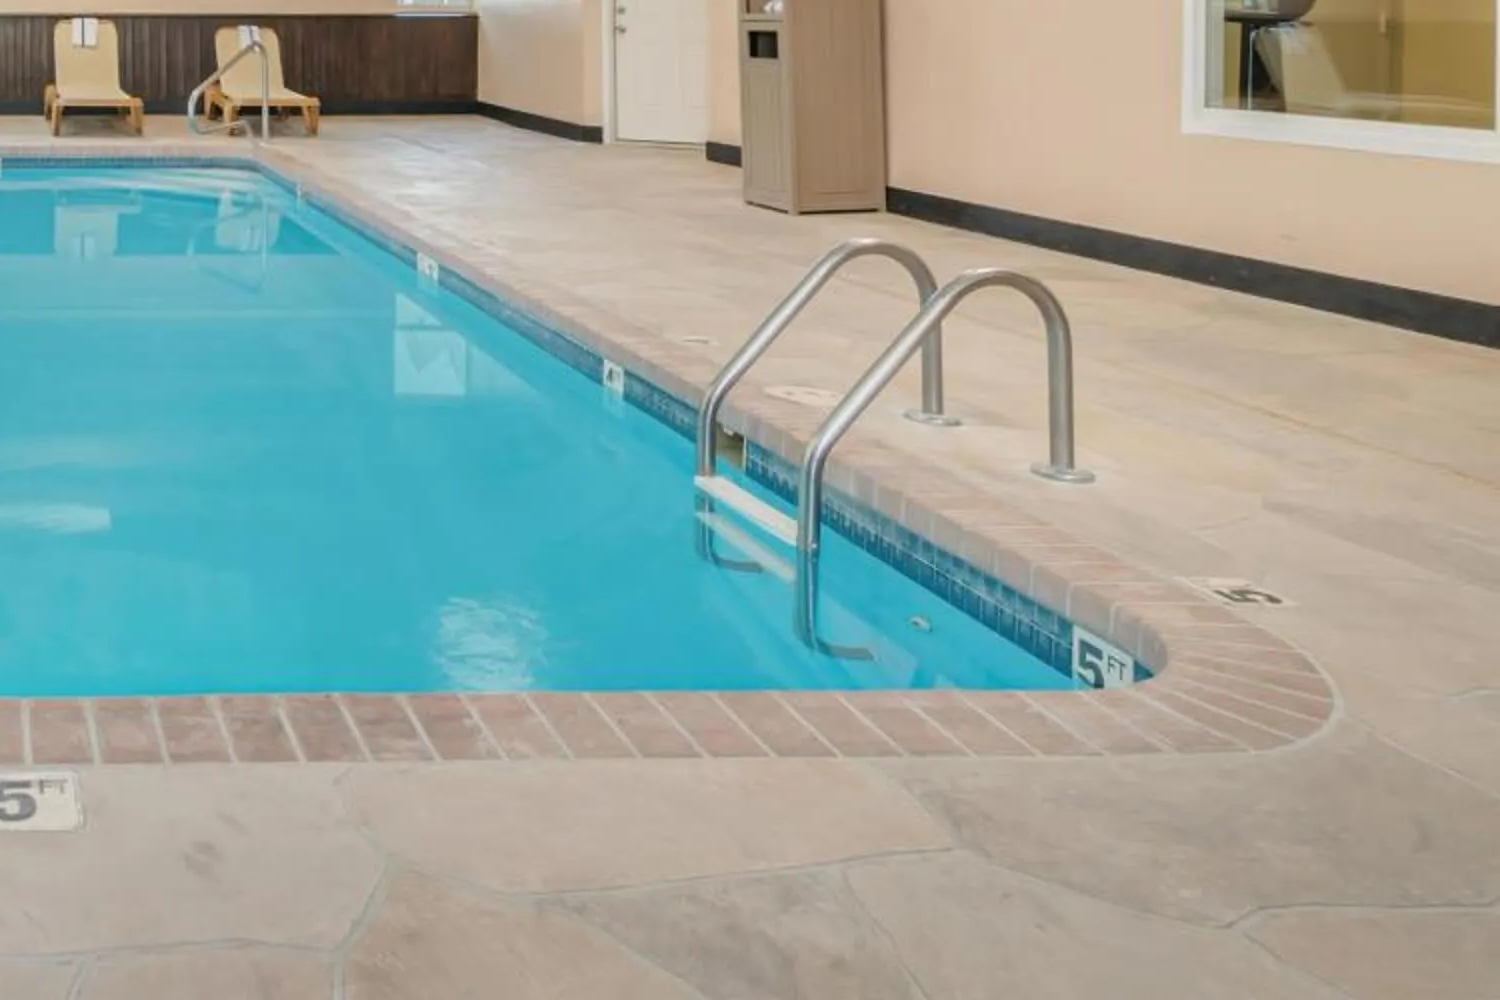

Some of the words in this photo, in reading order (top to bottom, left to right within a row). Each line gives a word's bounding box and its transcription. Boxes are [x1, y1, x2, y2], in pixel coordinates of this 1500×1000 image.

[1077, 639, 1105, 689] 5
[1107, 654, 1128, 681] FT
[38, 778, 69, 795] FT
